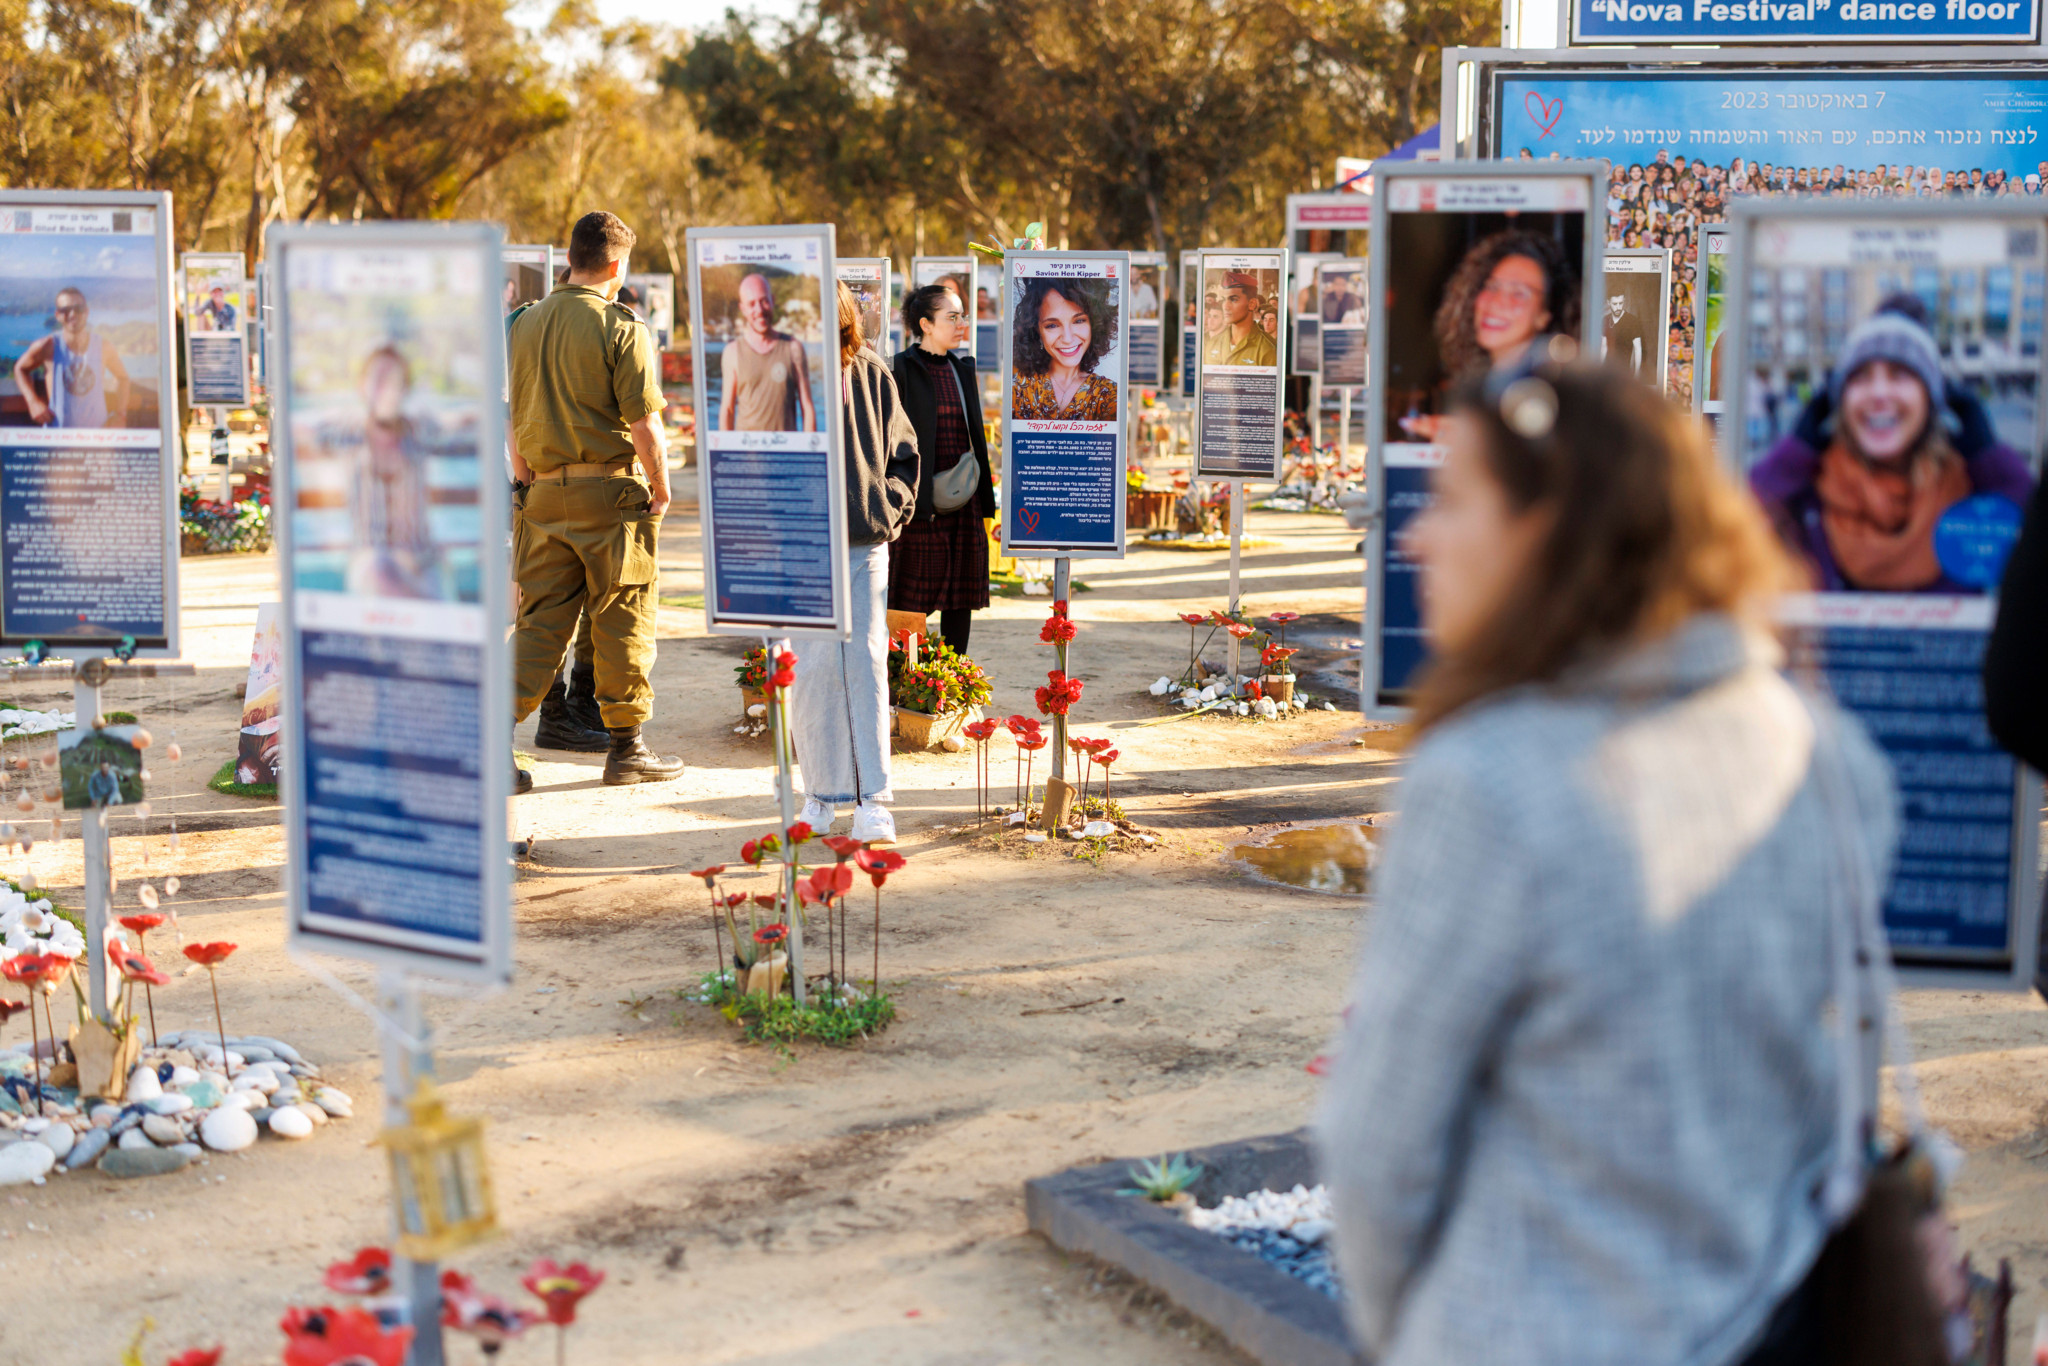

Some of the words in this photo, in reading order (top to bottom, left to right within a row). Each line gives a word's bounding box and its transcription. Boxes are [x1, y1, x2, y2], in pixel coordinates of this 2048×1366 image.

[1840, 0, 1936, 21] dance
[1945, 0, 2021, 20] floor
[1720, 92, 1769, 108] 2023
[1776, 92, 1868, 112] באוקטובר
[1874, 92, 1886, 108] 7
[1576, 126, 1616, 145] לעד.
[1624, 129, 1682, 145] שנדמו
[1689, 129, 1769, 144] והשמחה
[1776, 130, 1822, 144] האור
[1832, 130, 1857, 145] עם
[1866, 130, 1926, 146] אתכם,
[1934, 130, 1981, 144] נזכור
[1990, 126, 2038, 145] לנצח
